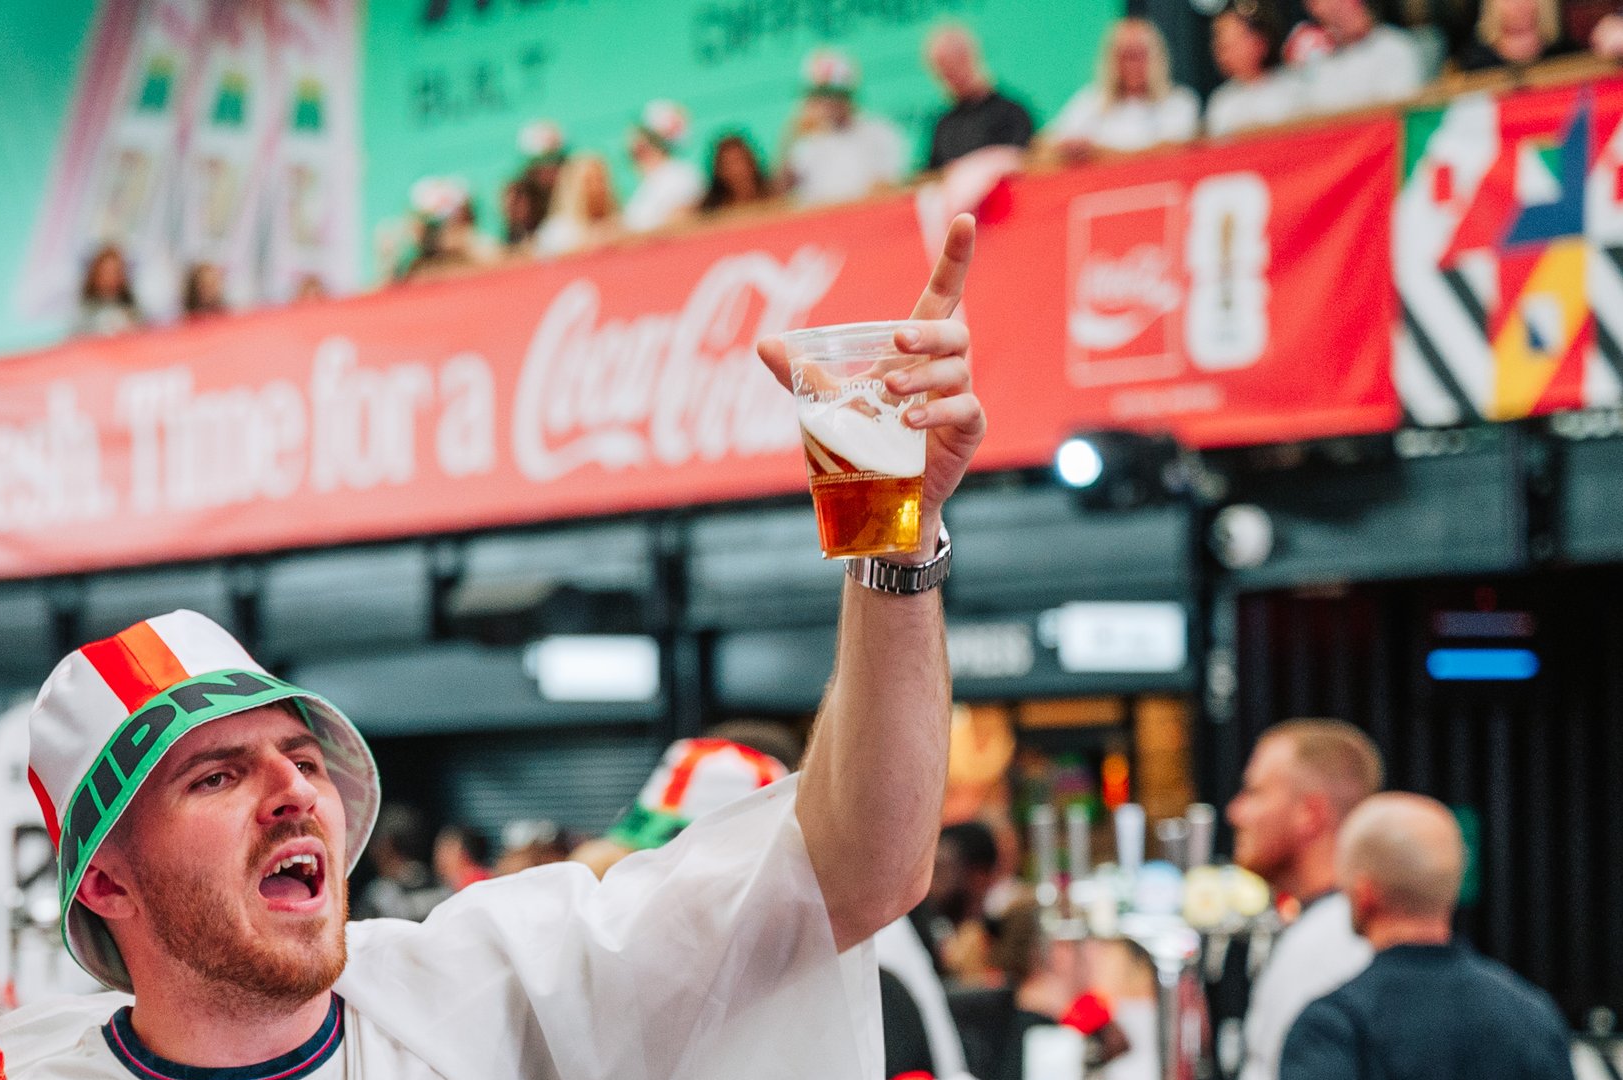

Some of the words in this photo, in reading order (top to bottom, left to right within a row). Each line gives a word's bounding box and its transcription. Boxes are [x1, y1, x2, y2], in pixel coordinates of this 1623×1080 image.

[114, 364, 305, 516] Time
[311, 338, 427, 494] for
[437, 352, 497, 478] a
[62, 671, 291, 902] MIDN
